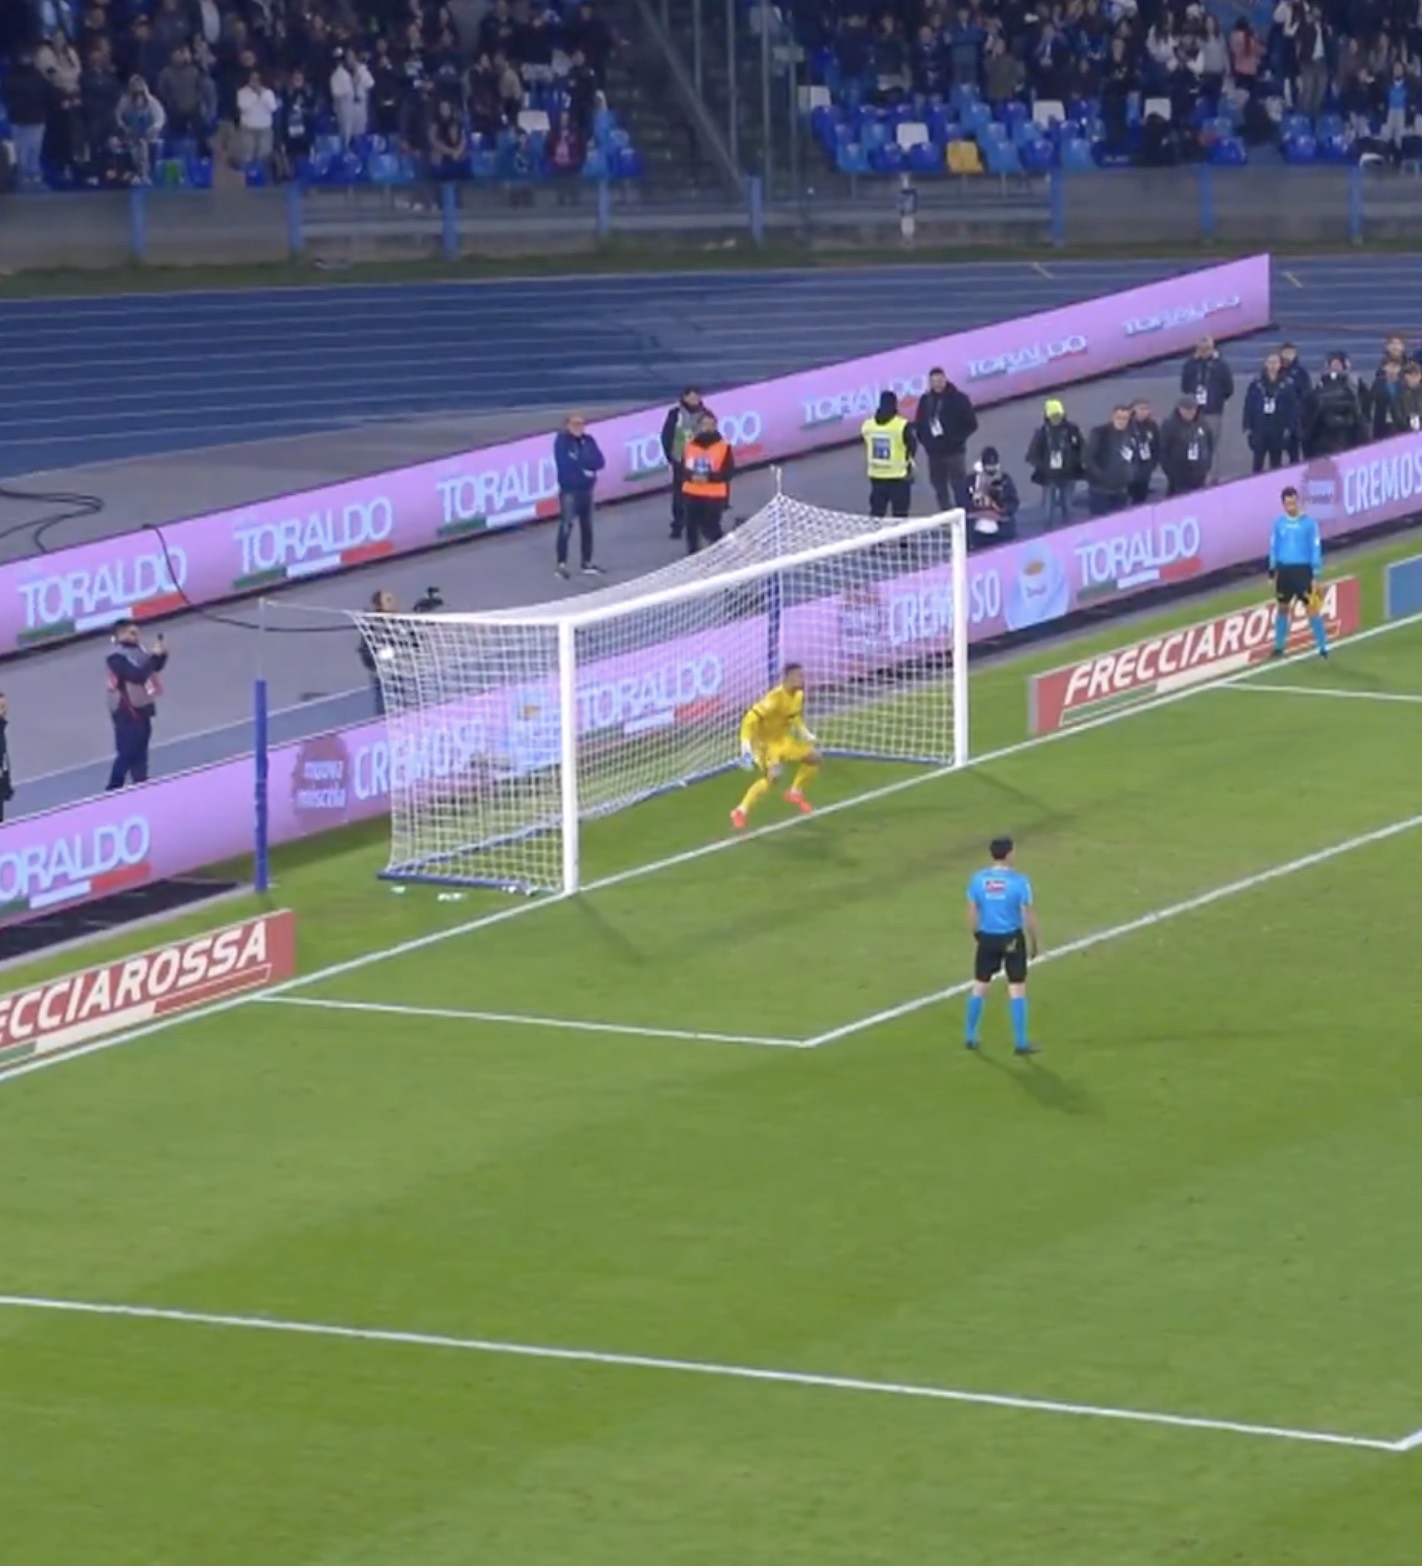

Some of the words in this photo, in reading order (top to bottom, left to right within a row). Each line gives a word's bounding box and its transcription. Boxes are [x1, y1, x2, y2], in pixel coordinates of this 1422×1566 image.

[967, 335, 1088, 379] TORALDO
[233, 501, 394, 574] TORALDO
[1075, 518, 1200, 586] TORALDO
[18, 546, 188, 626] TORALDO
[889, 569, 1001, 645] CREMSO
[577, 655, 723, 732] TORALDO
